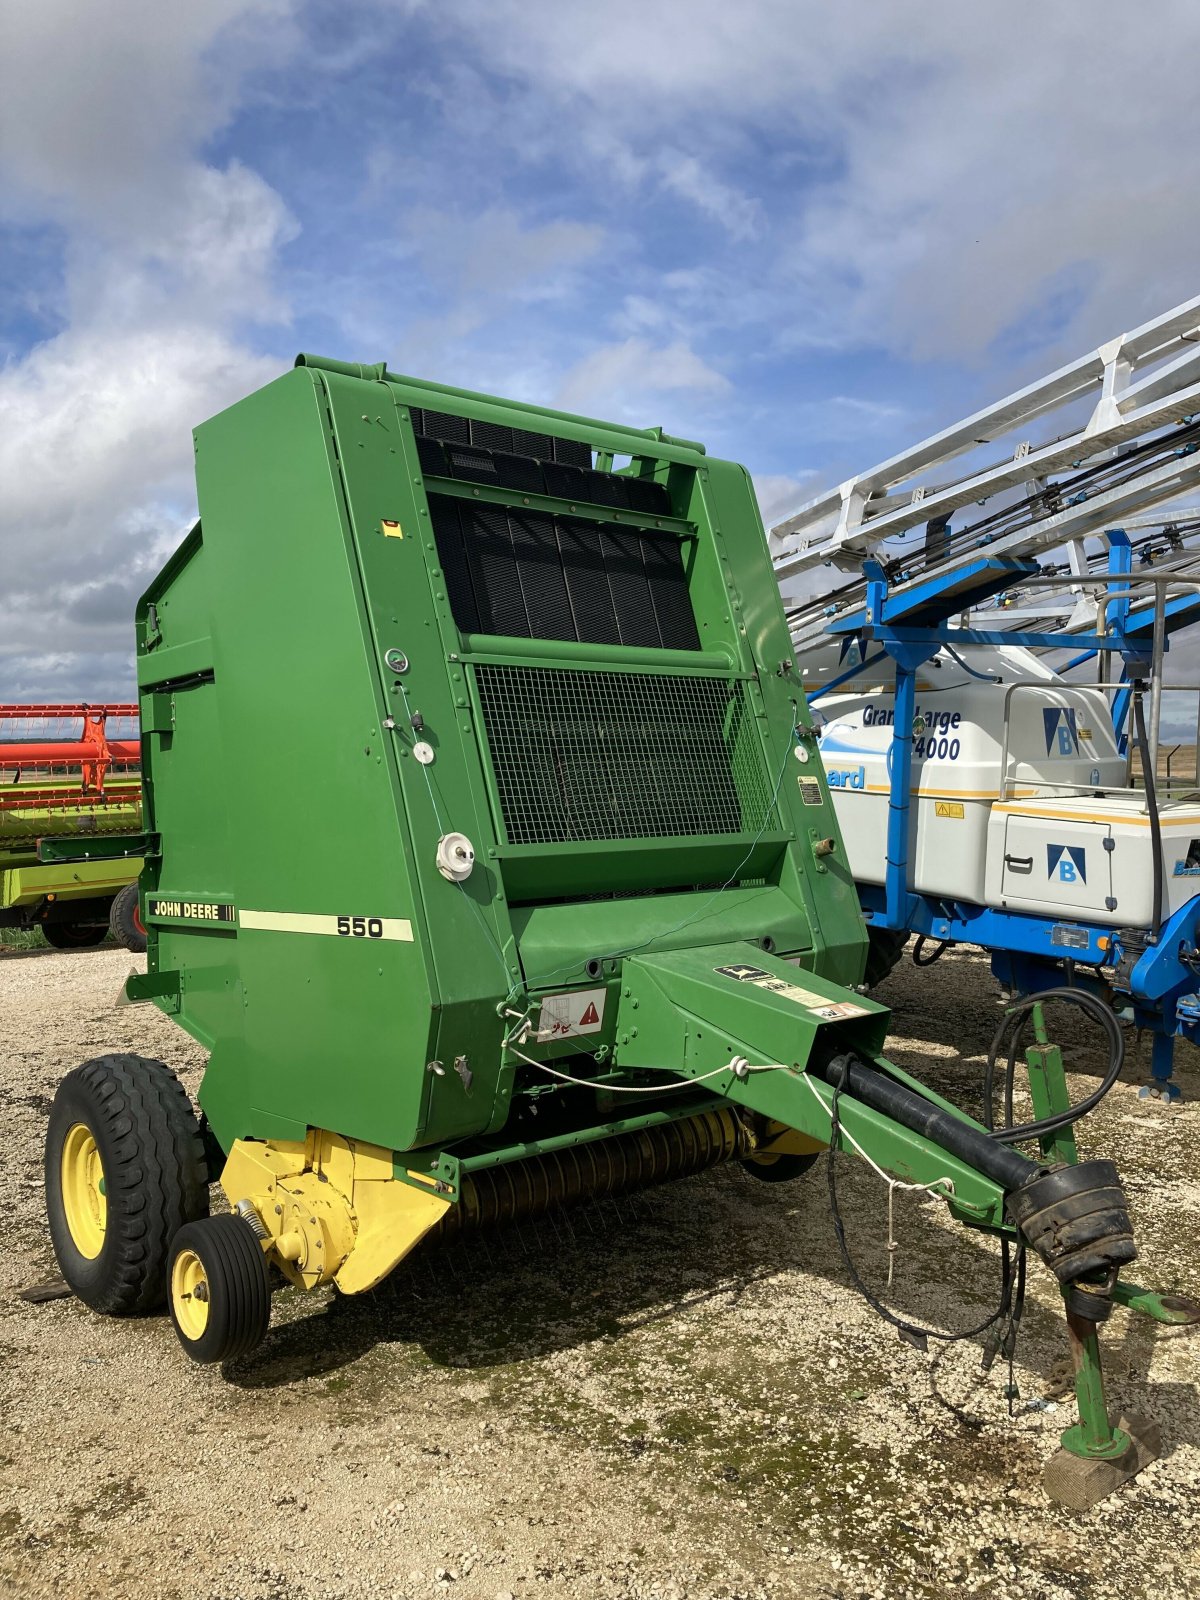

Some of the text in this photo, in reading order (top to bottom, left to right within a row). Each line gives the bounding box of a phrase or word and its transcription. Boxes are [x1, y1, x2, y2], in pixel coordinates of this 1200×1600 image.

[863, 704, 894, 726] Gran
[912, 736, 960, 760] 4000
[1058, 727, 1072, 755] B
[1059, 860, 1077, 882] B
[154, 901, 219, 920] JOHN DEERE
[337, 916, 383, 938] 550
